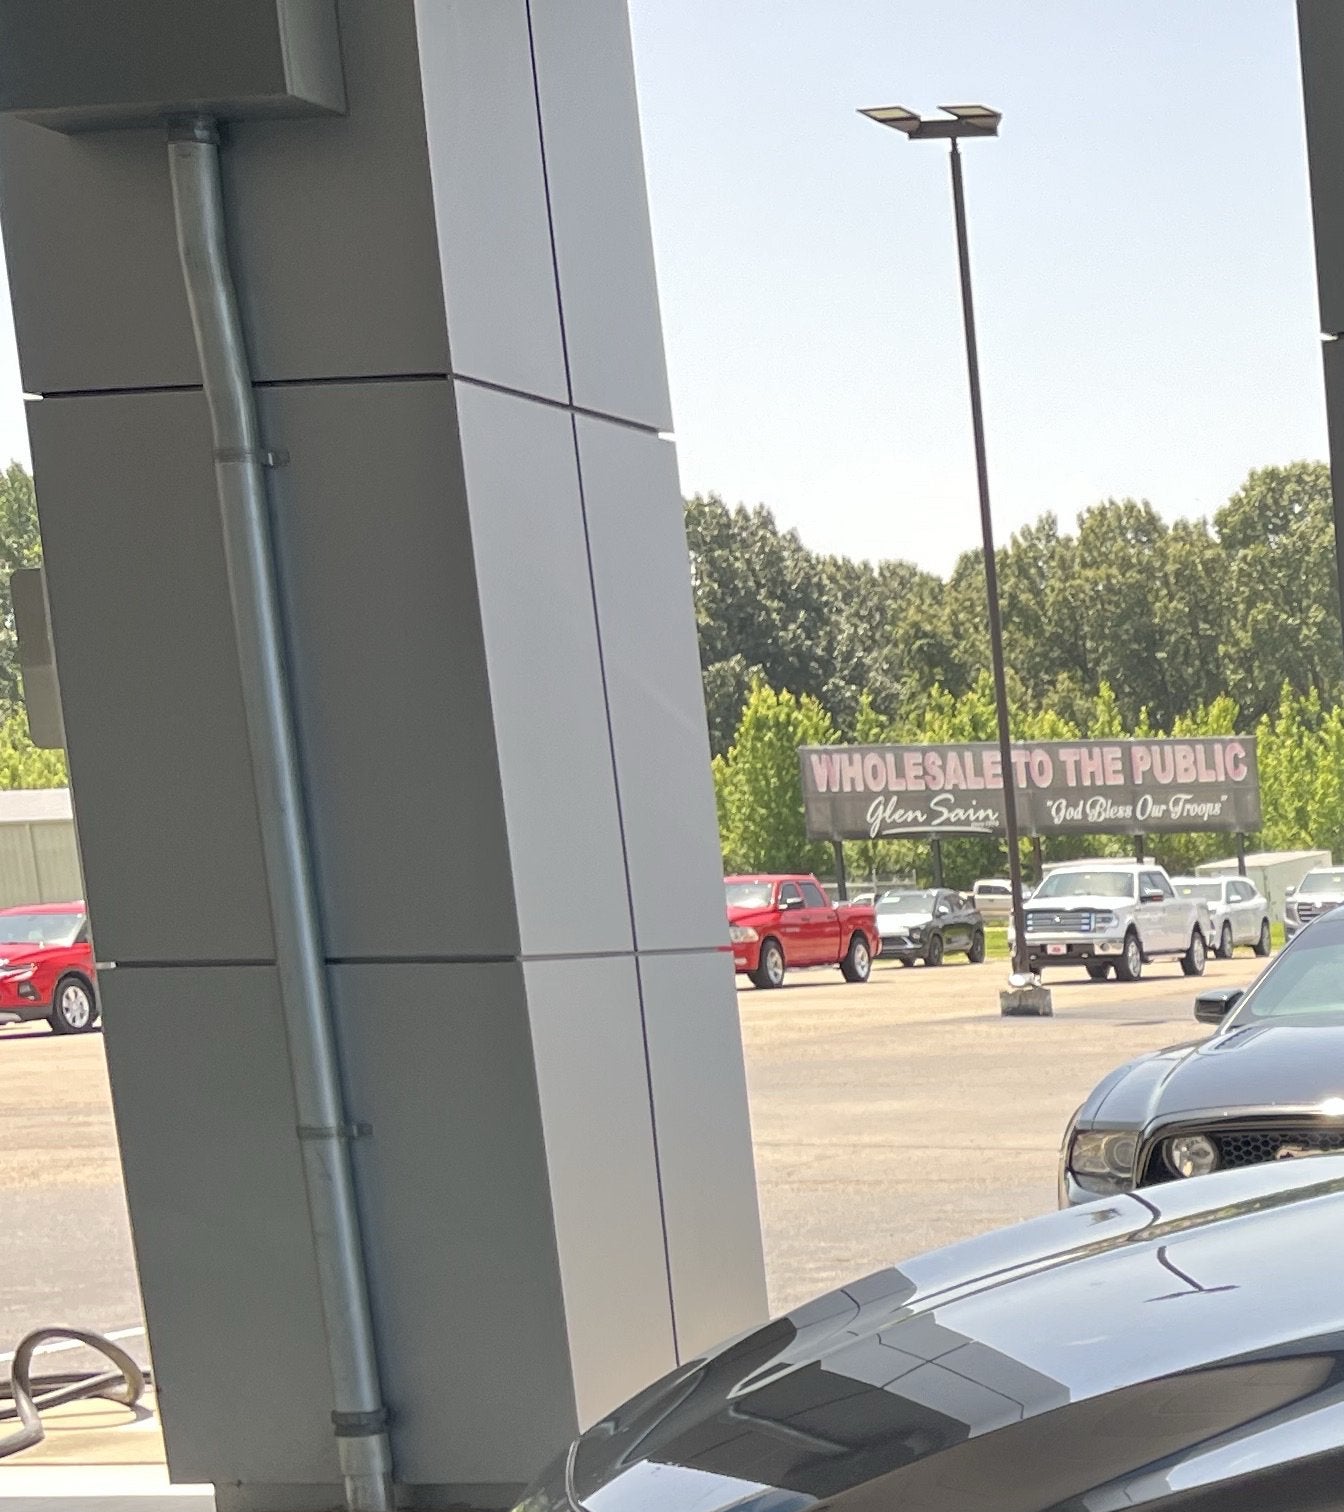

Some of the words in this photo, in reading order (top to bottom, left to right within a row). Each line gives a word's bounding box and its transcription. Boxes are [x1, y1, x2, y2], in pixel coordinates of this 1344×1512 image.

[810, 750, 1003, 792] WHOLESALE
[1011, 749, 1053, 788] TO
[1059, 746, 1124, 787] THE
[1131, 742, 1248, 785] PUBLIC
[867, 795, 927, 839] Glen
[930, 793, 998, 825] Sain
[1086, 795, 1132, 823] Bless
[1136, 794, 1166, 821] Our
